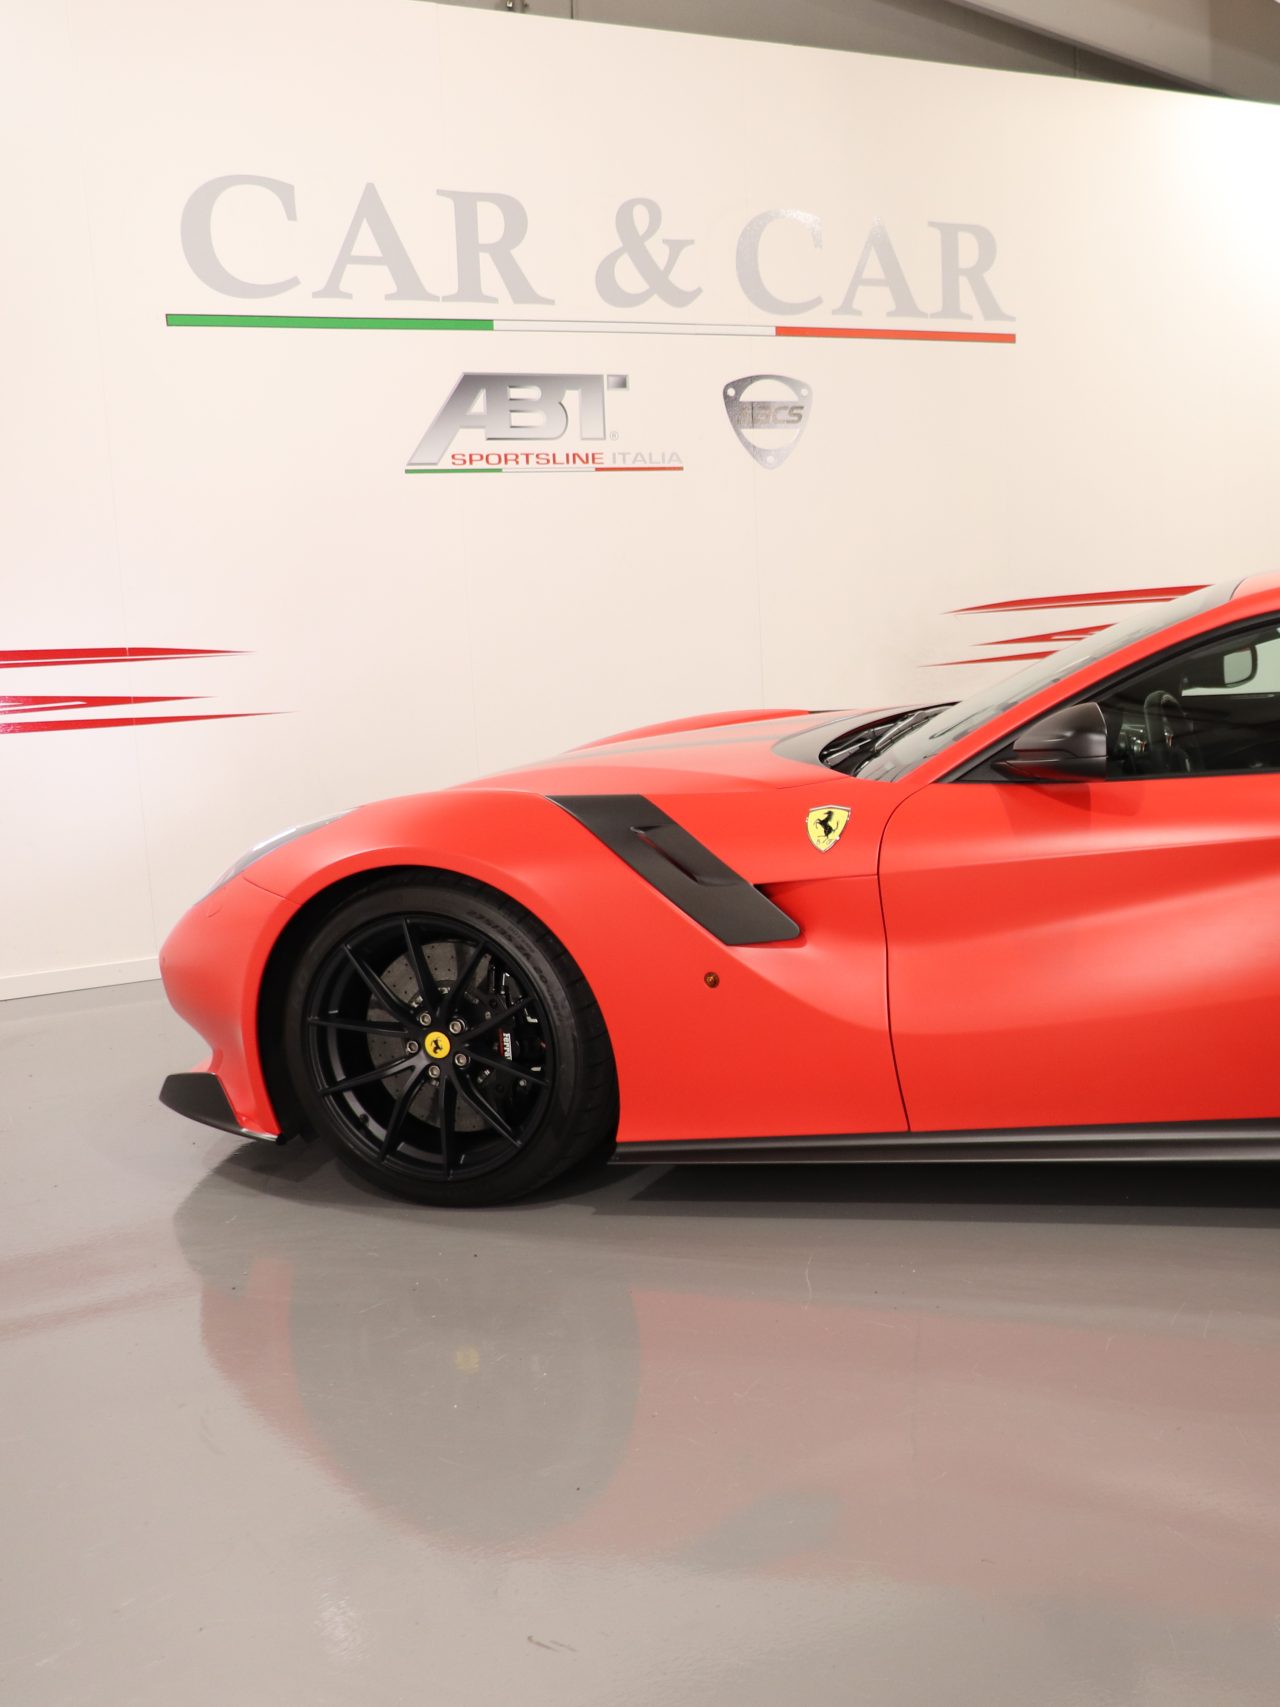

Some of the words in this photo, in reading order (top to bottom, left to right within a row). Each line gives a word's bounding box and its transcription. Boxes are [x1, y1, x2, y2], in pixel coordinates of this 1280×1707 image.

[180, 174, 555, 305] CAR
[595, 197, 704, 308] &
[735, 208, 1017, 321] CAR
[406, 372, 606, 466] ABT
[451, 452, 605, 466] SPORTSLINE
[611, 451, 684, 465] ITALIA
